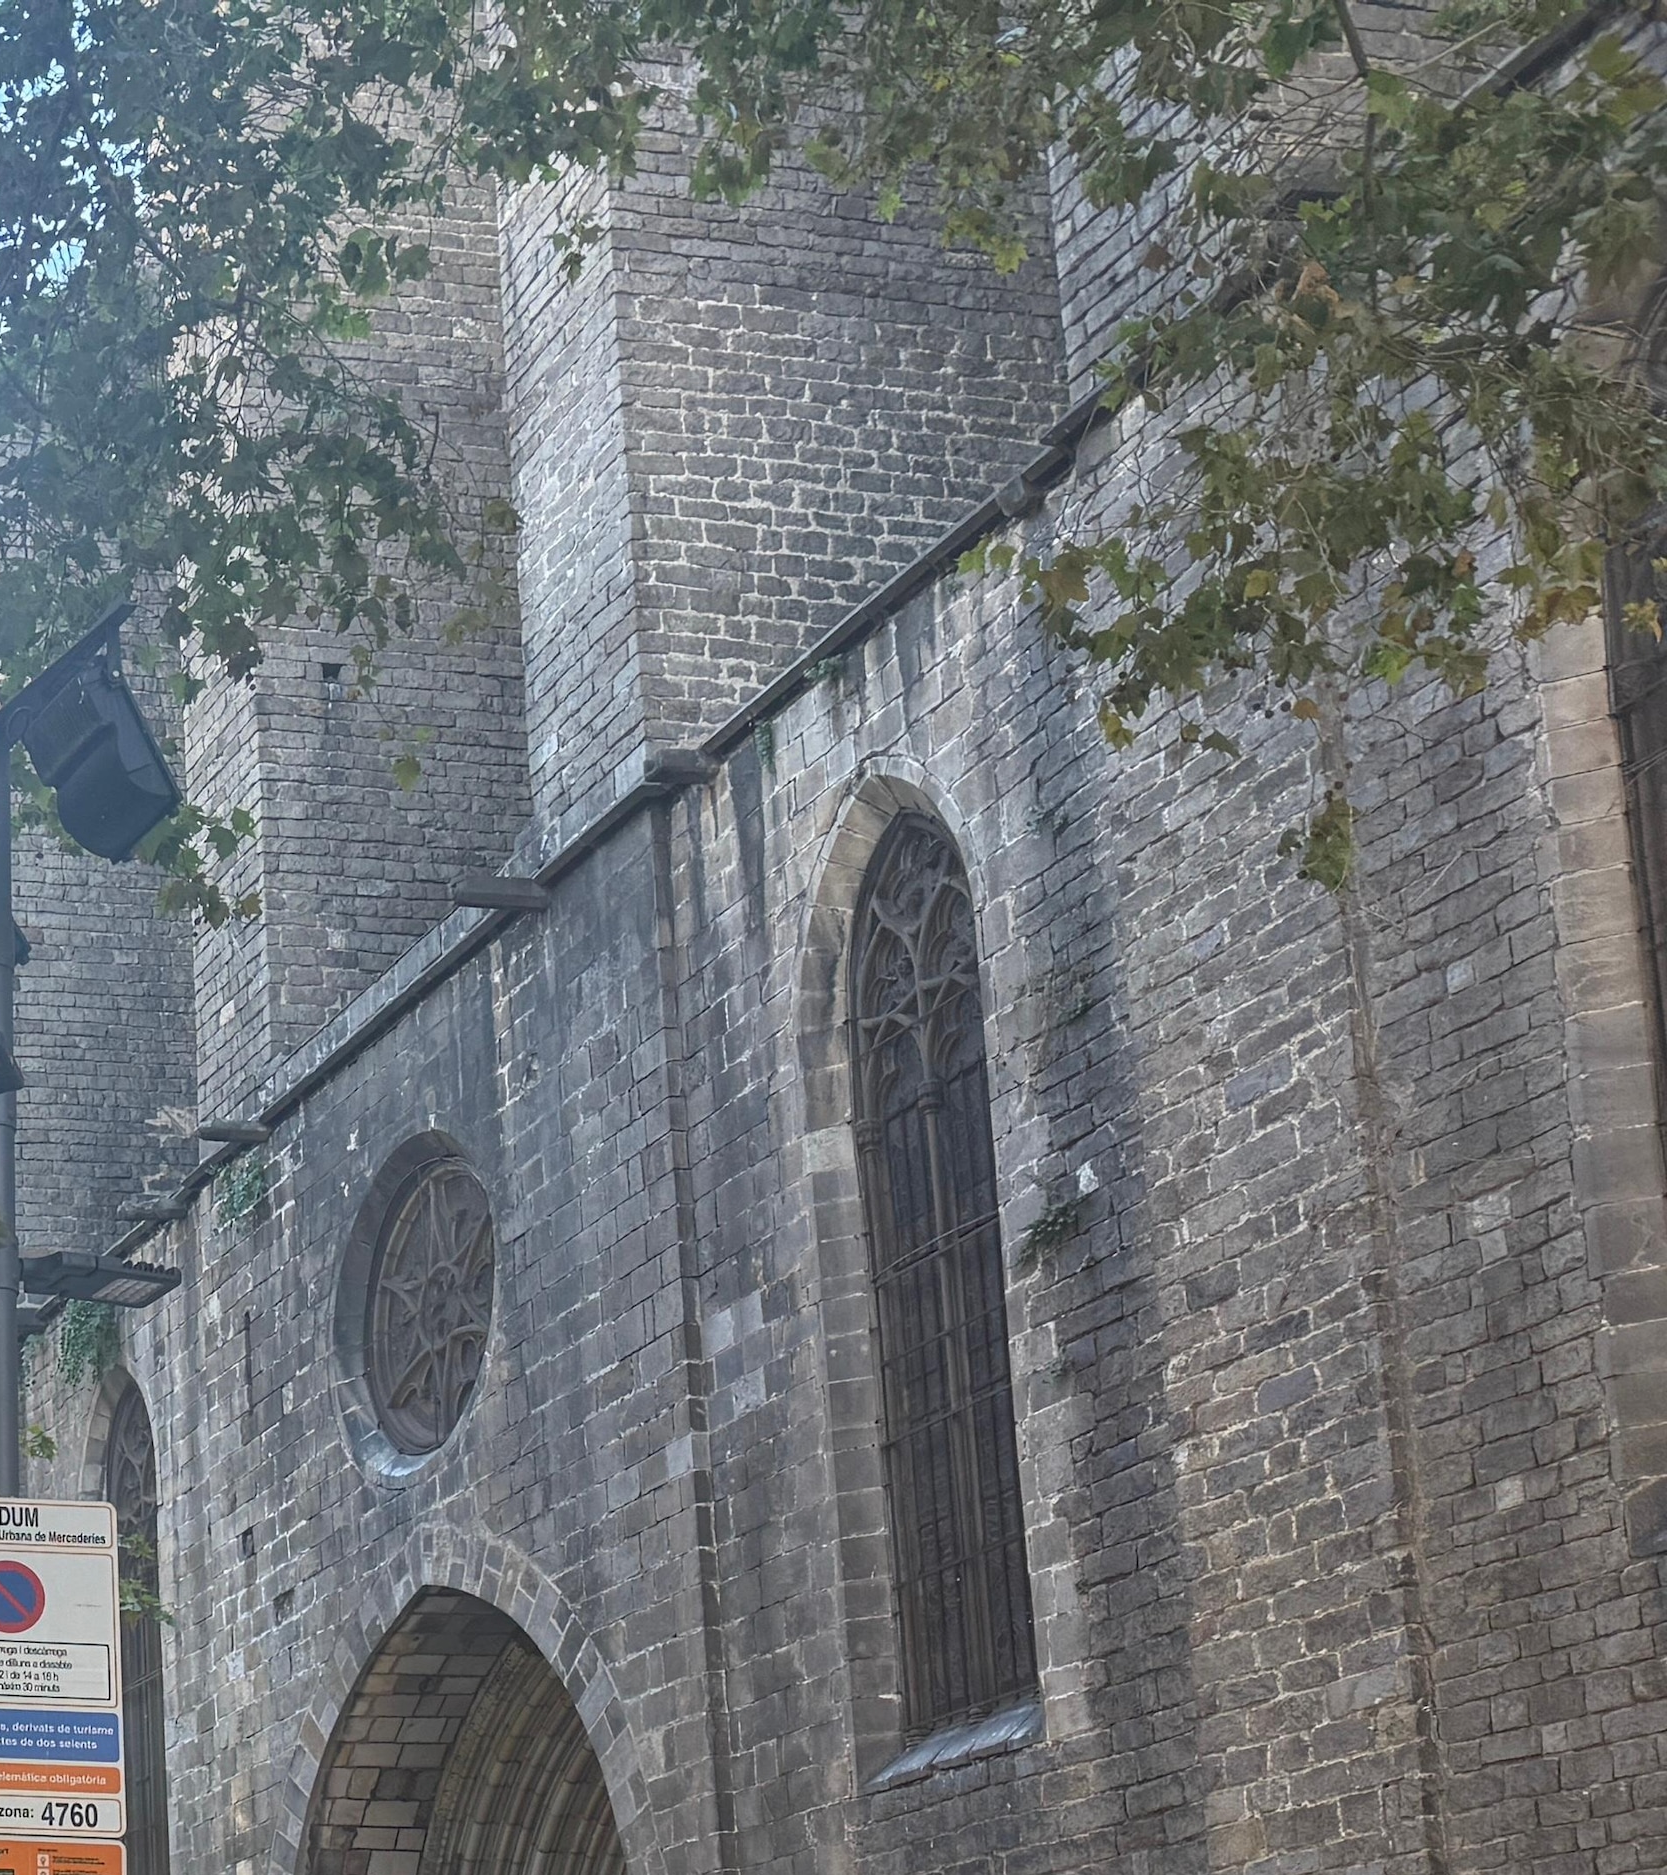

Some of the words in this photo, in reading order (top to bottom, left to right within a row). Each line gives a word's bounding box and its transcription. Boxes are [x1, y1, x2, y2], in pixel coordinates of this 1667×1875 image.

[35, 1530, 46, 1542] de
[49, 1531, 106, 1545] Mercaderies
[53, 1671, 59, 1681] h
[12, 1721, 55, 1734] derivats
[57, 1723, 71, 1735] de
[73, 1724, 114, 1736] turisme
[20, 1737, 34, 1747] de
[36, 1737, 56, 1748] dos
[59, 1738, 98, 1750] seients
[49, 1772, 107, 1788] obligatòria
[41, 1802, 98, 1828] 4760
